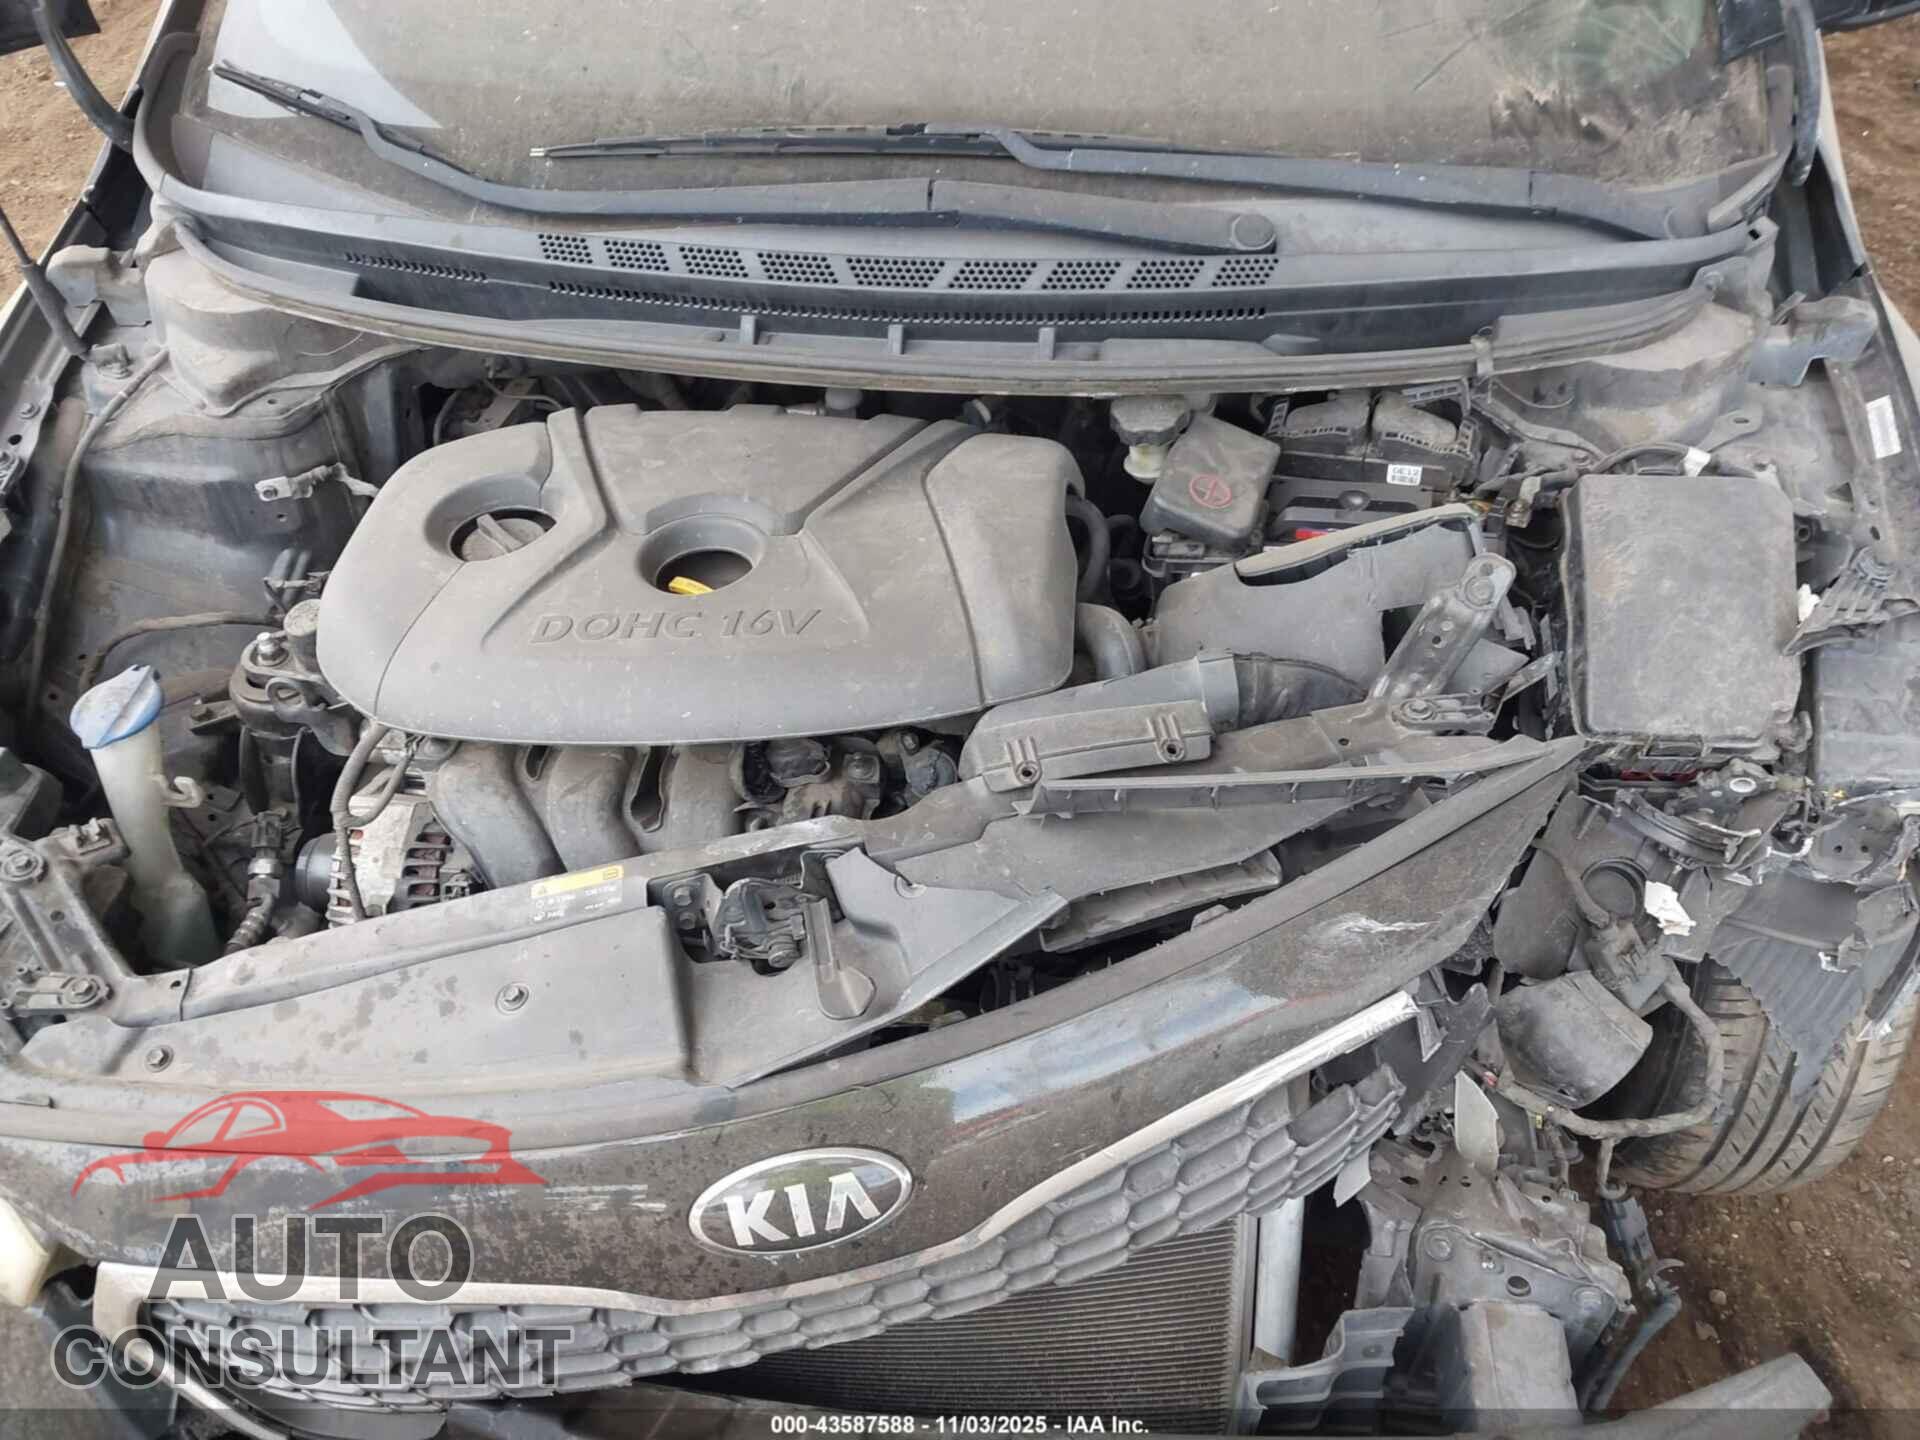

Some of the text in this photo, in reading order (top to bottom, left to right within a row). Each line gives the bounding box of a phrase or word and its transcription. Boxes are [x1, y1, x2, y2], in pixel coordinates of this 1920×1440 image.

[530, 608, 822, 644] DOHC 16V
[723, 1171, 881, 1246] KIA
